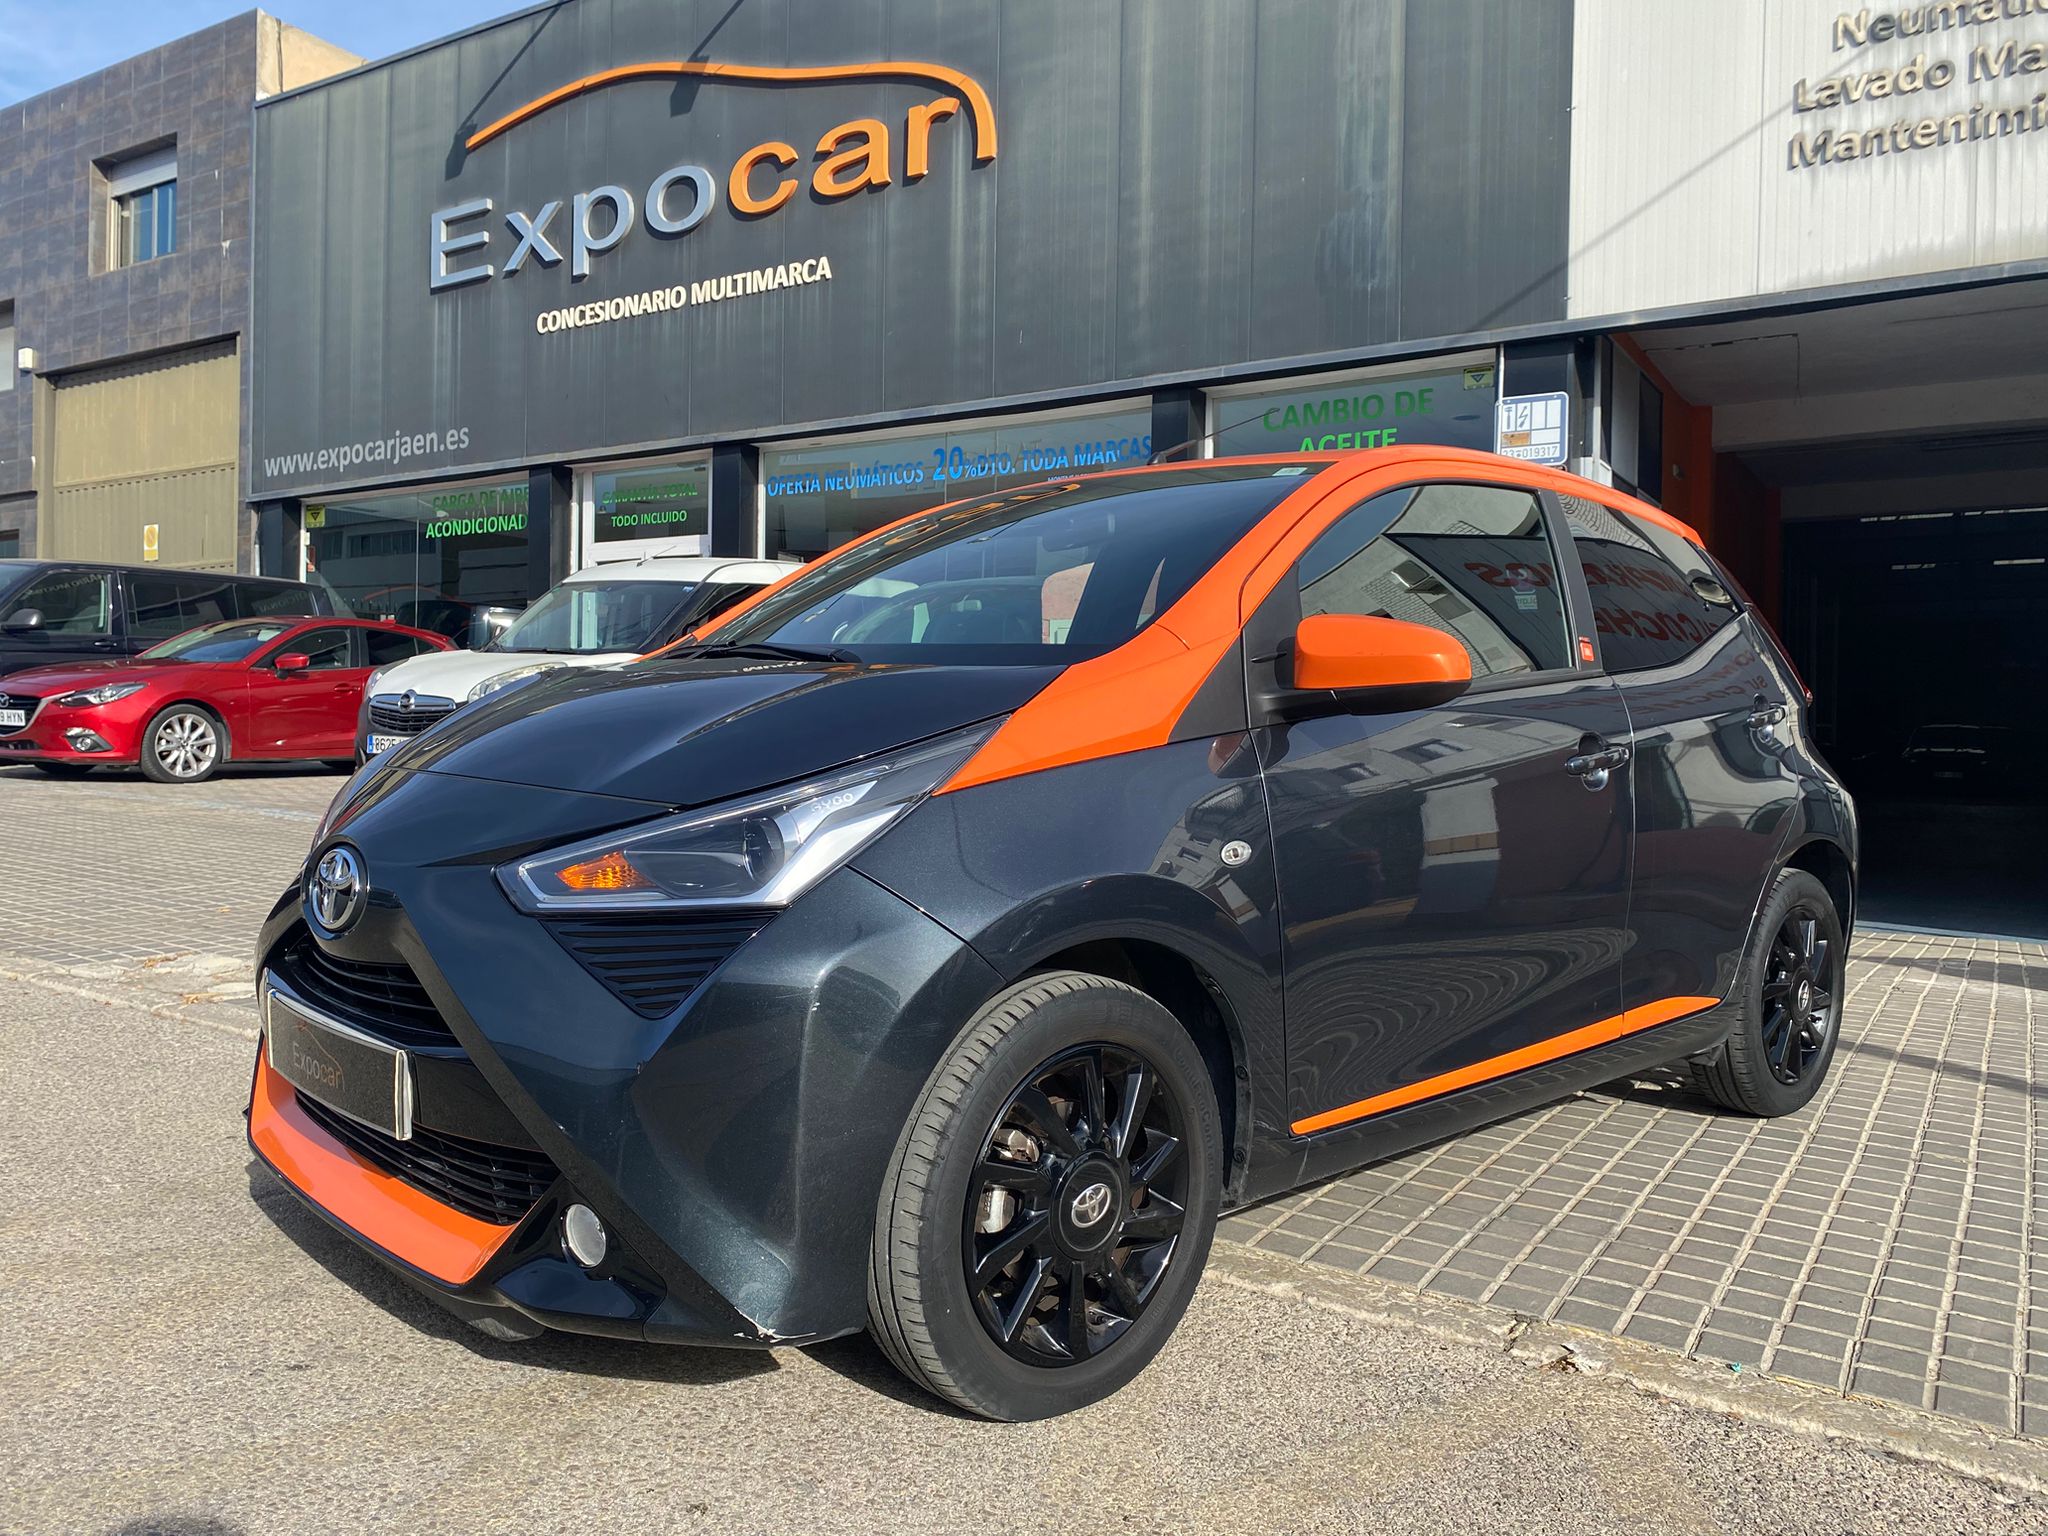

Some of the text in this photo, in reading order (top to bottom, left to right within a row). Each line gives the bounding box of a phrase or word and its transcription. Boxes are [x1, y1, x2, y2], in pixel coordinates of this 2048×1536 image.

[1793, 53, 1956, 114] Lavado
[1787, 92, 2048, 170] Mantenimi
[430, 96, 960, 288] Expocar
[536, 256, 833, 335] CONCESIONARIO MULTIMARCA
[1263, 387, 1434, 432] CAMBIO DE
[264, 427, 470, 477] www.expocarjaen.es
[767, 471, 821, 497] OFERTA
[825, 460, 924, 492] NEUMÁTICOS
[1023, 446, 1069, 472] TODA
[1073, 435, 1151, 468] MARCAS
[1300, 427, 1397, 452] ACEITE
[611, 510, 687, 528] TODO INCLUIDO
[292, 1041, 341, 1089] Expocar
